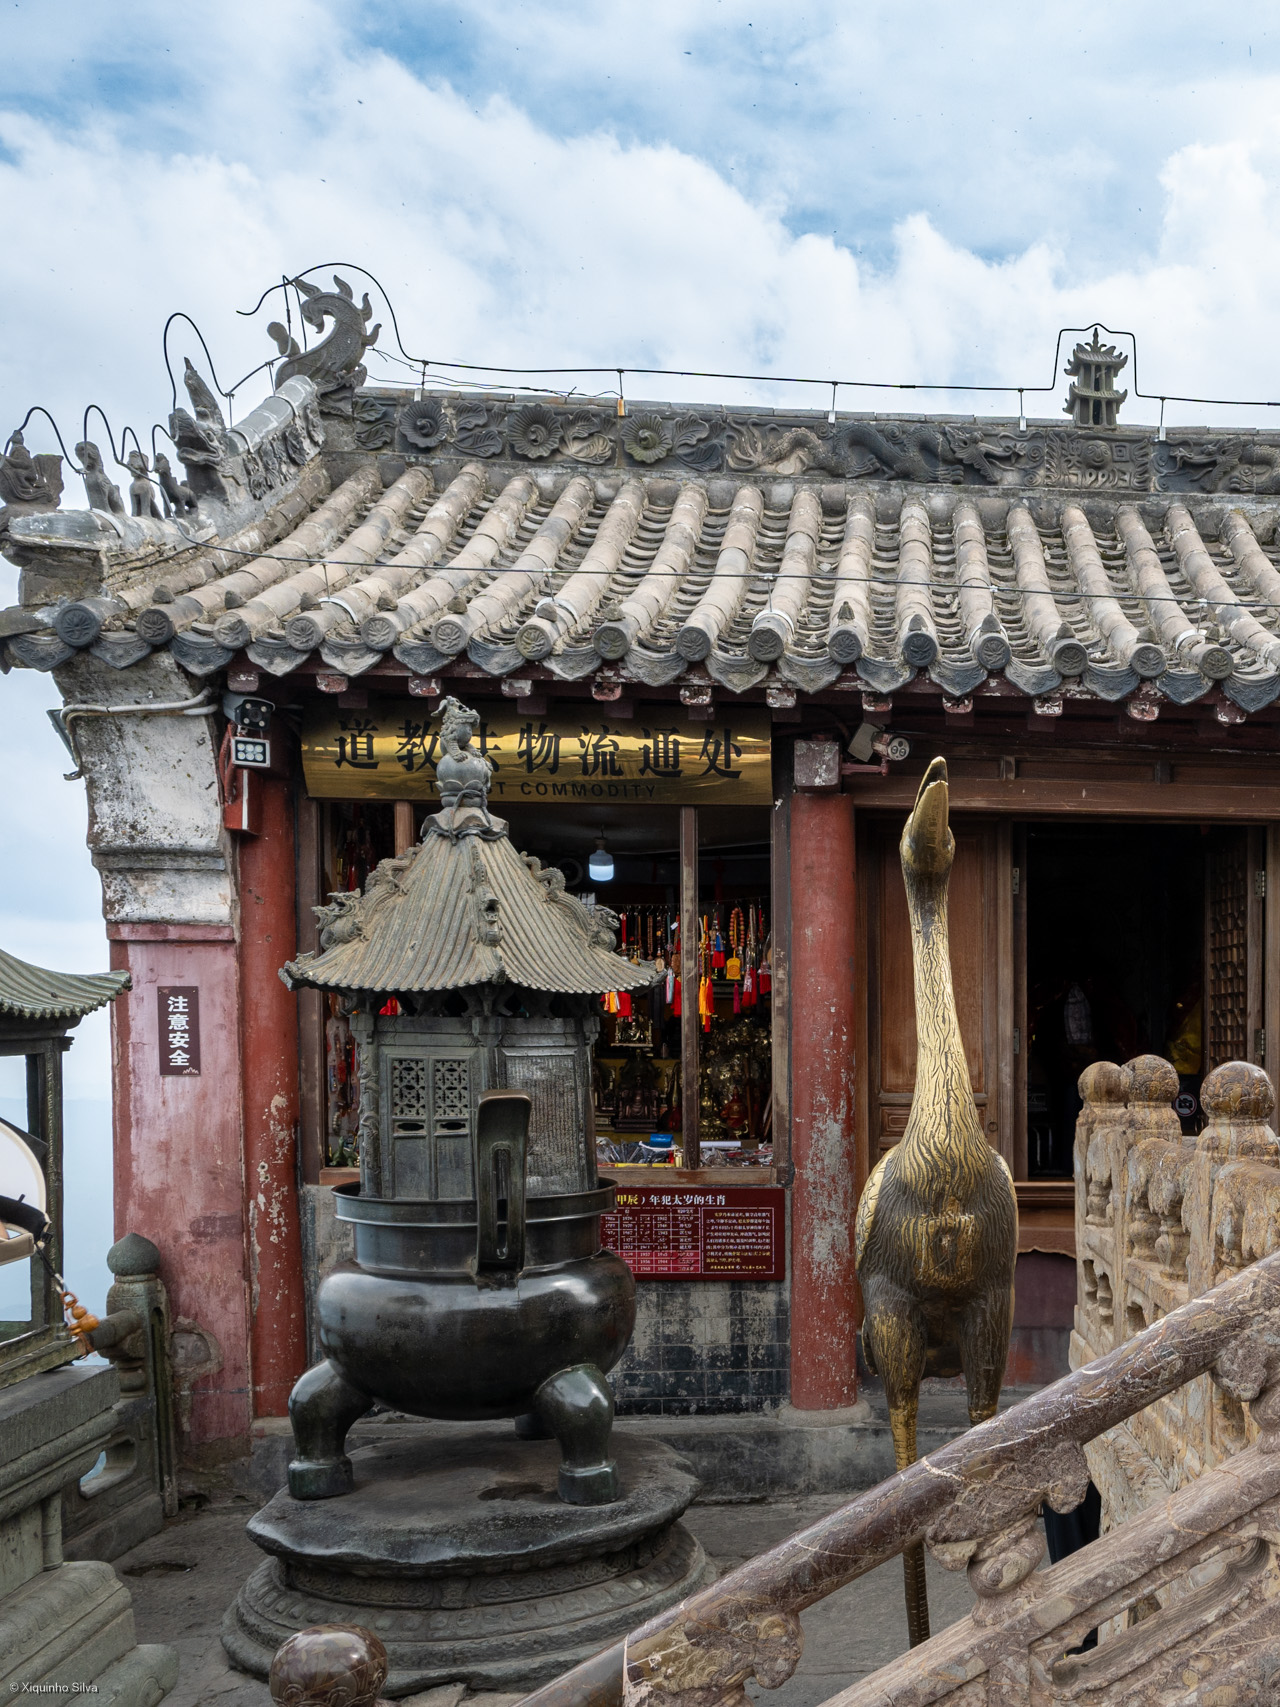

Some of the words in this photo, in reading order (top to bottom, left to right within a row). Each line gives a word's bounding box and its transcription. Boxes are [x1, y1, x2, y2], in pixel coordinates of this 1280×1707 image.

[520, 781, 656, 797] COMMODITY
[167, 995, 190, 1066] 注意安全
